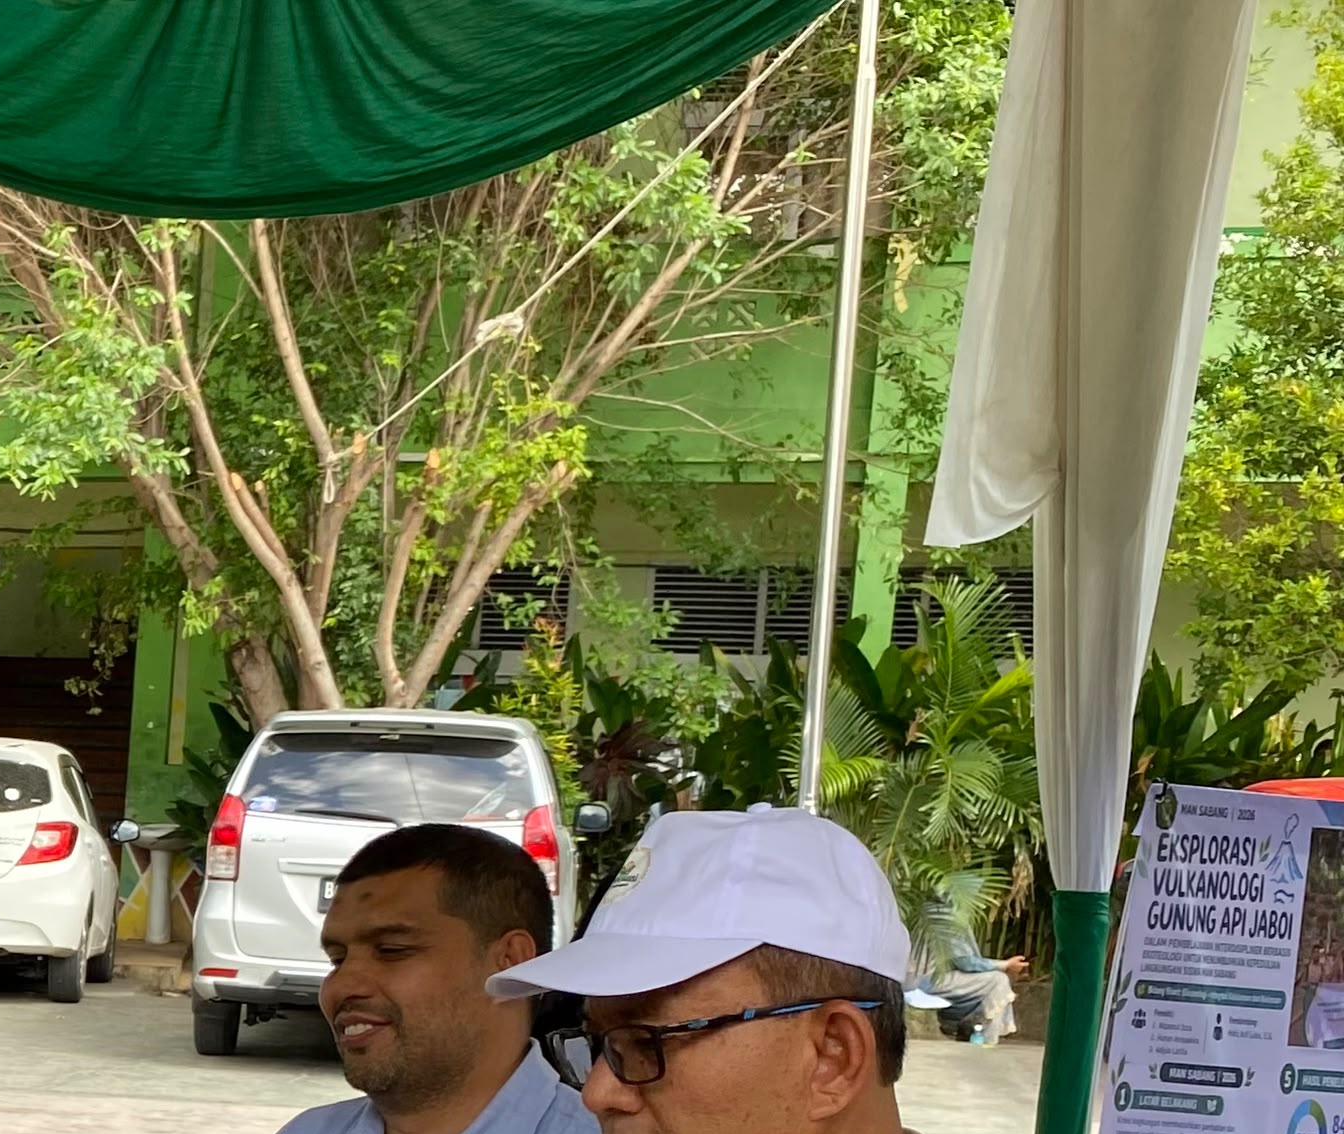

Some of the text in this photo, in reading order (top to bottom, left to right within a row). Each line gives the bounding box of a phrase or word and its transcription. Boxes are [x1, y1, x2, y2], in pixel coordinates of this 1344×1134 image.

[1181, 804, 1197, 815] MAN
[1199, 805, 1228, 818] SABANG
[1156, 832, 1256, 867] EKSPLORASI
[1153, 867, 1265, 903] VULKANOLOGI
[1147, 900, 1293, 940] GUNUNG API JABOI
[1169, 1068, 1186, 1079] MAN
[1188, 1069, 1215, 1081] SABANG
[1284, 1071, 1292, 1088] 5
[1119, 1088, 1127, 1105] 1
